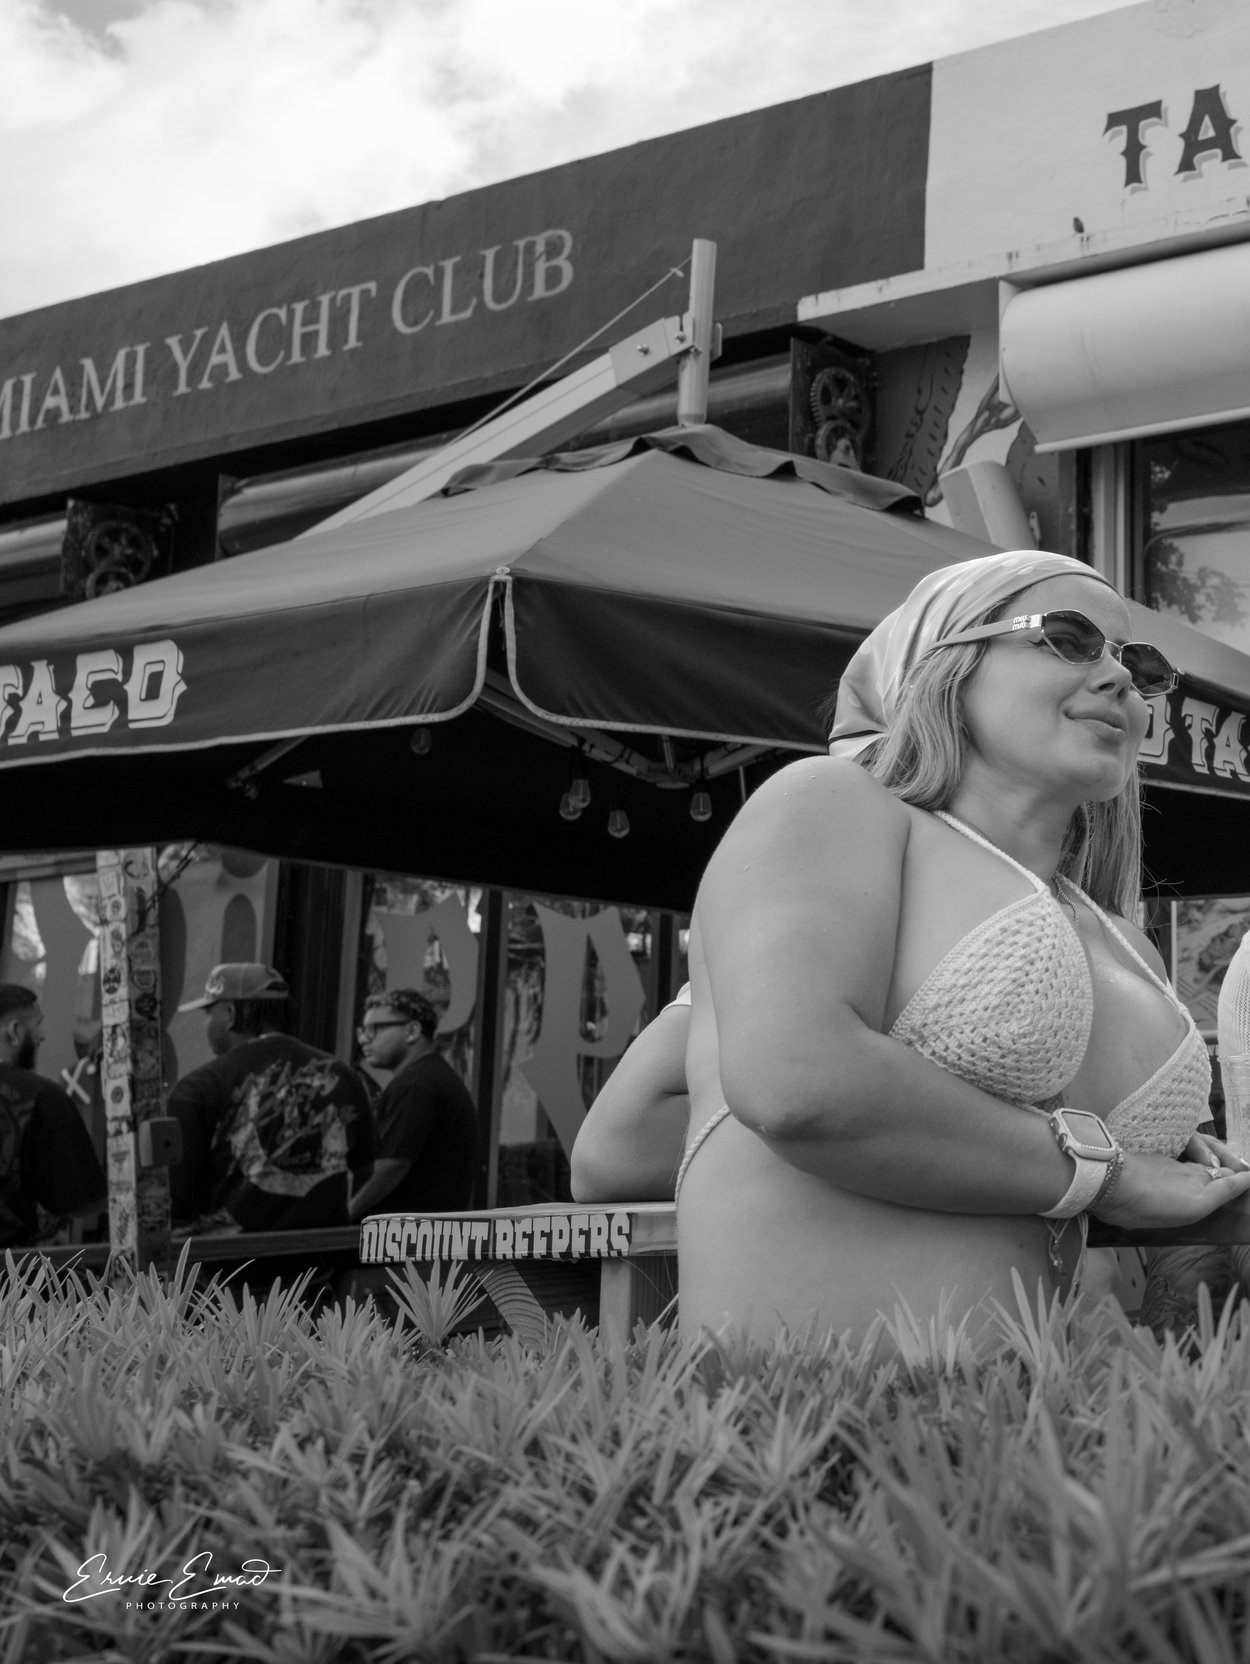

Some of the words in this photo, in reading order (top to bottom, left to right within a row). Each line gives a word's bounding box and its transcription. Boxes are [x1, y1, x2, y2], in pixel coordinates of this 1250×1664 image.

[165, 281, 377, 397] YACHT
[391, 229, 574, 334] CLUB
[361, 1217, 490, 1263] DISCOUNT
